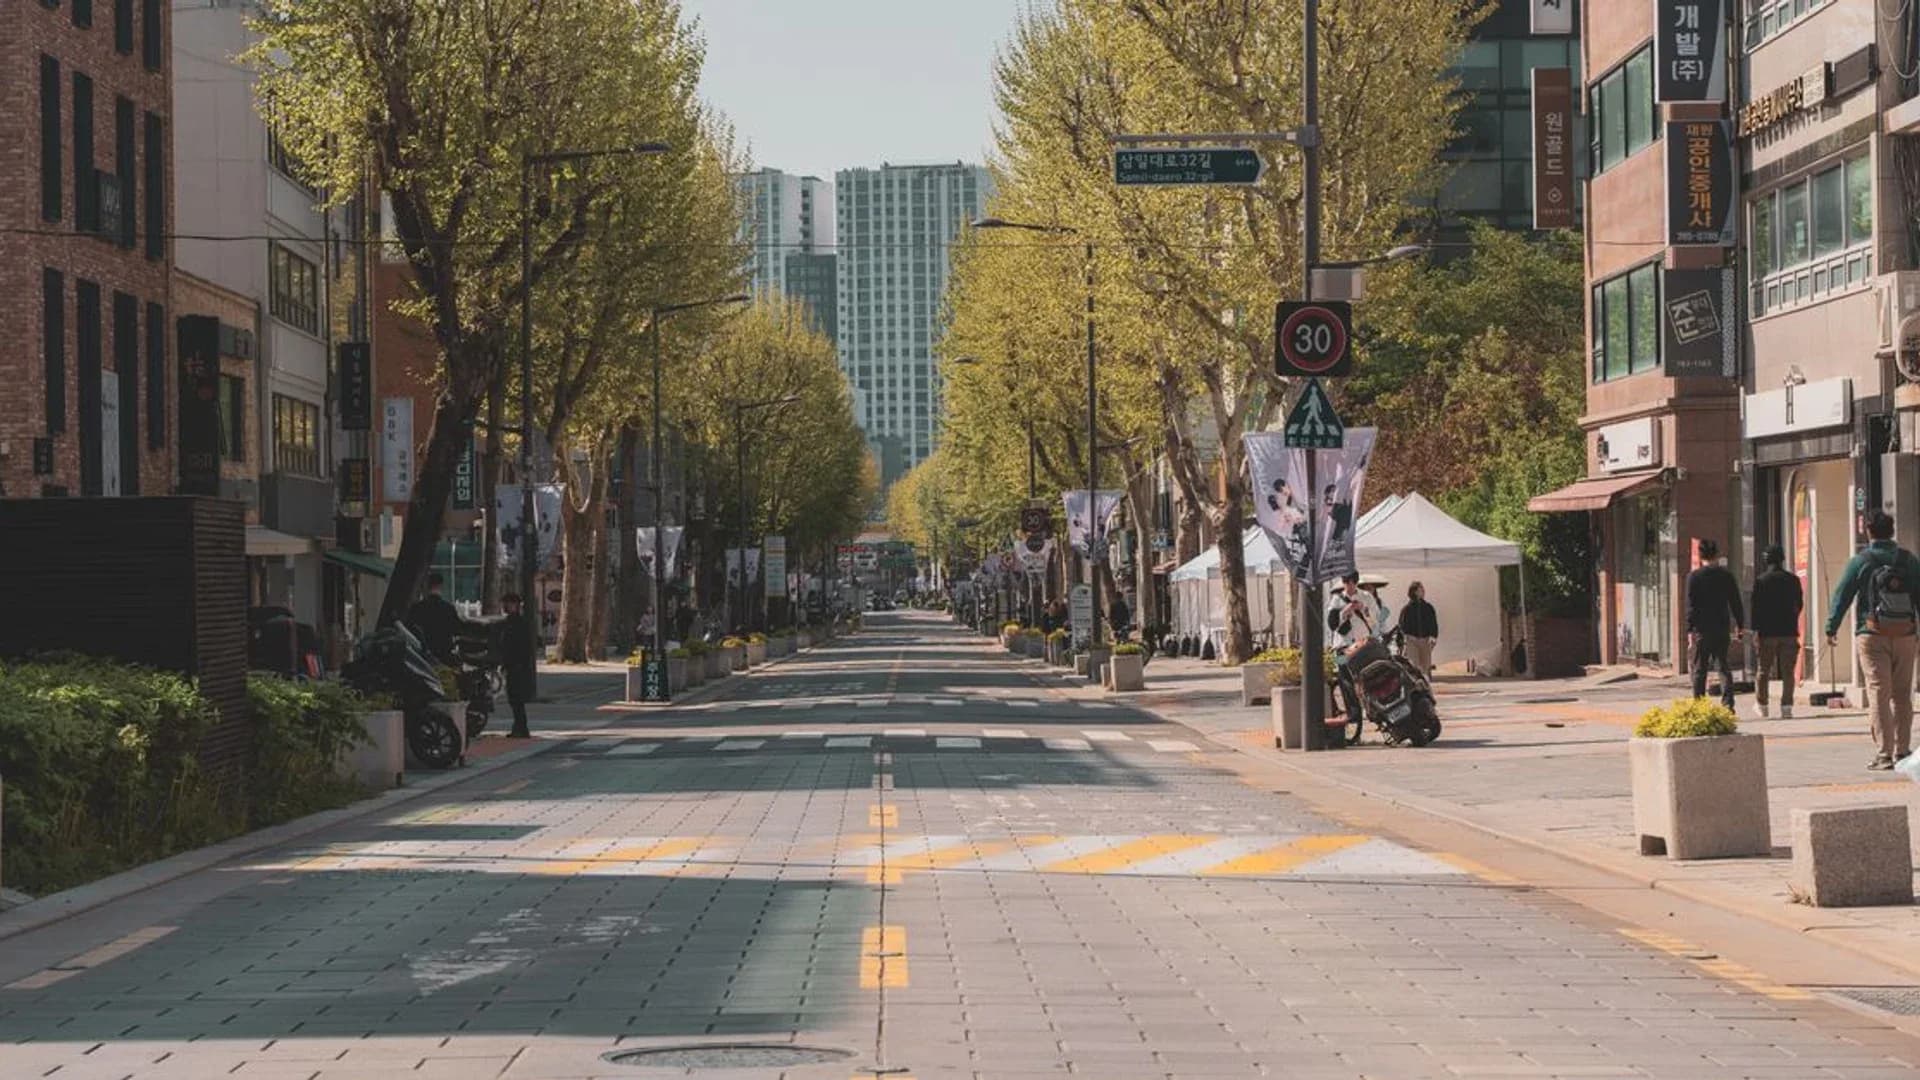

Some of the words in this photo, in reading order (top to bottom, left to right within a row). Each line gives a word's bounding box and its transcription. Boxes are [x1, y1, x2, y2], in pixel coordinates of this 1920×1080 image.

[1119, 152, 1212, 169] 삼일대로32길
[1688, 138, 1712, 228] 공인중개사
[1295, 323, 1332, 354] 30
